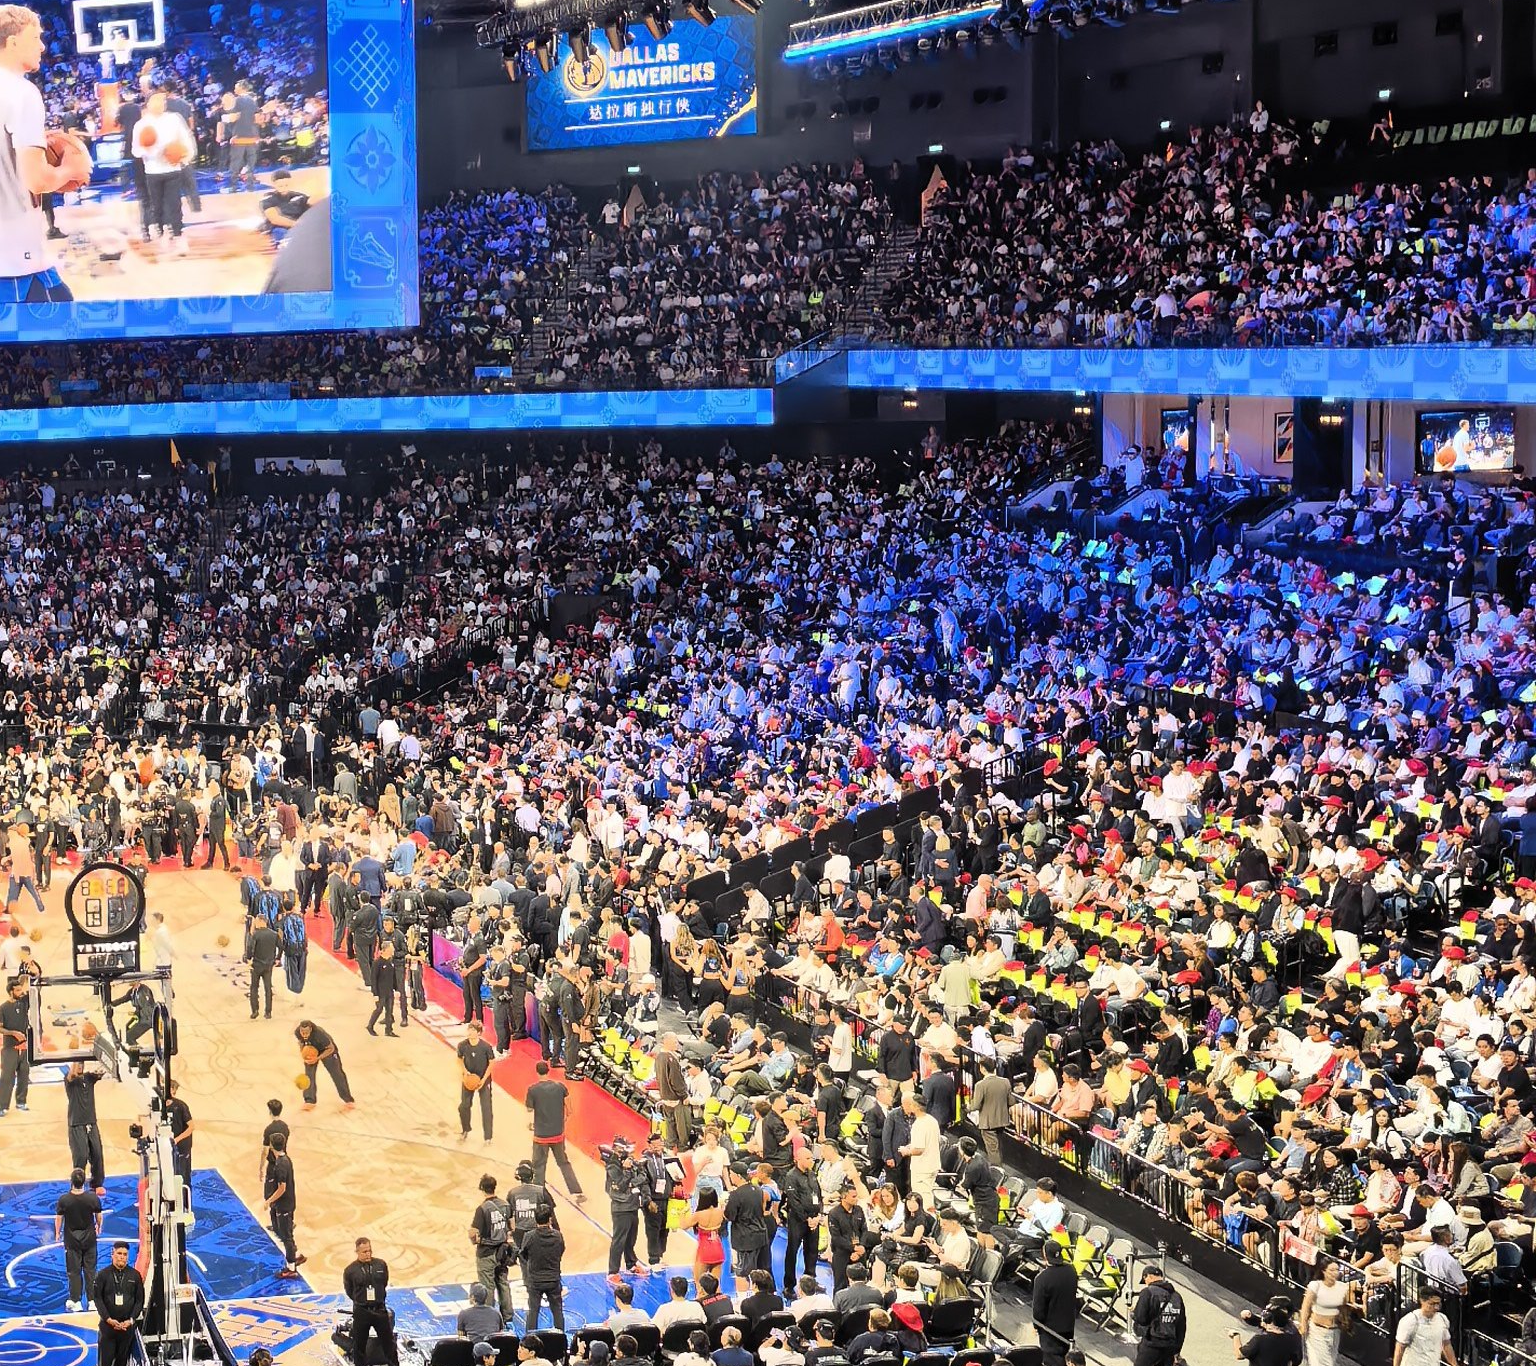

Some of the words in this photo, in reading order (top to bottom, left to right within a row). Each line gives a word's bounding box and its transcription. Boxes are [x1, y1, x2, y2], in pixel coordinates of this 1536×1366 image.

[610, 42, 680, 67] DALLAS
[610, 61, 716, 90] MAVERICKS
[588, 98, 691, 121] 达拉斯独行侠
